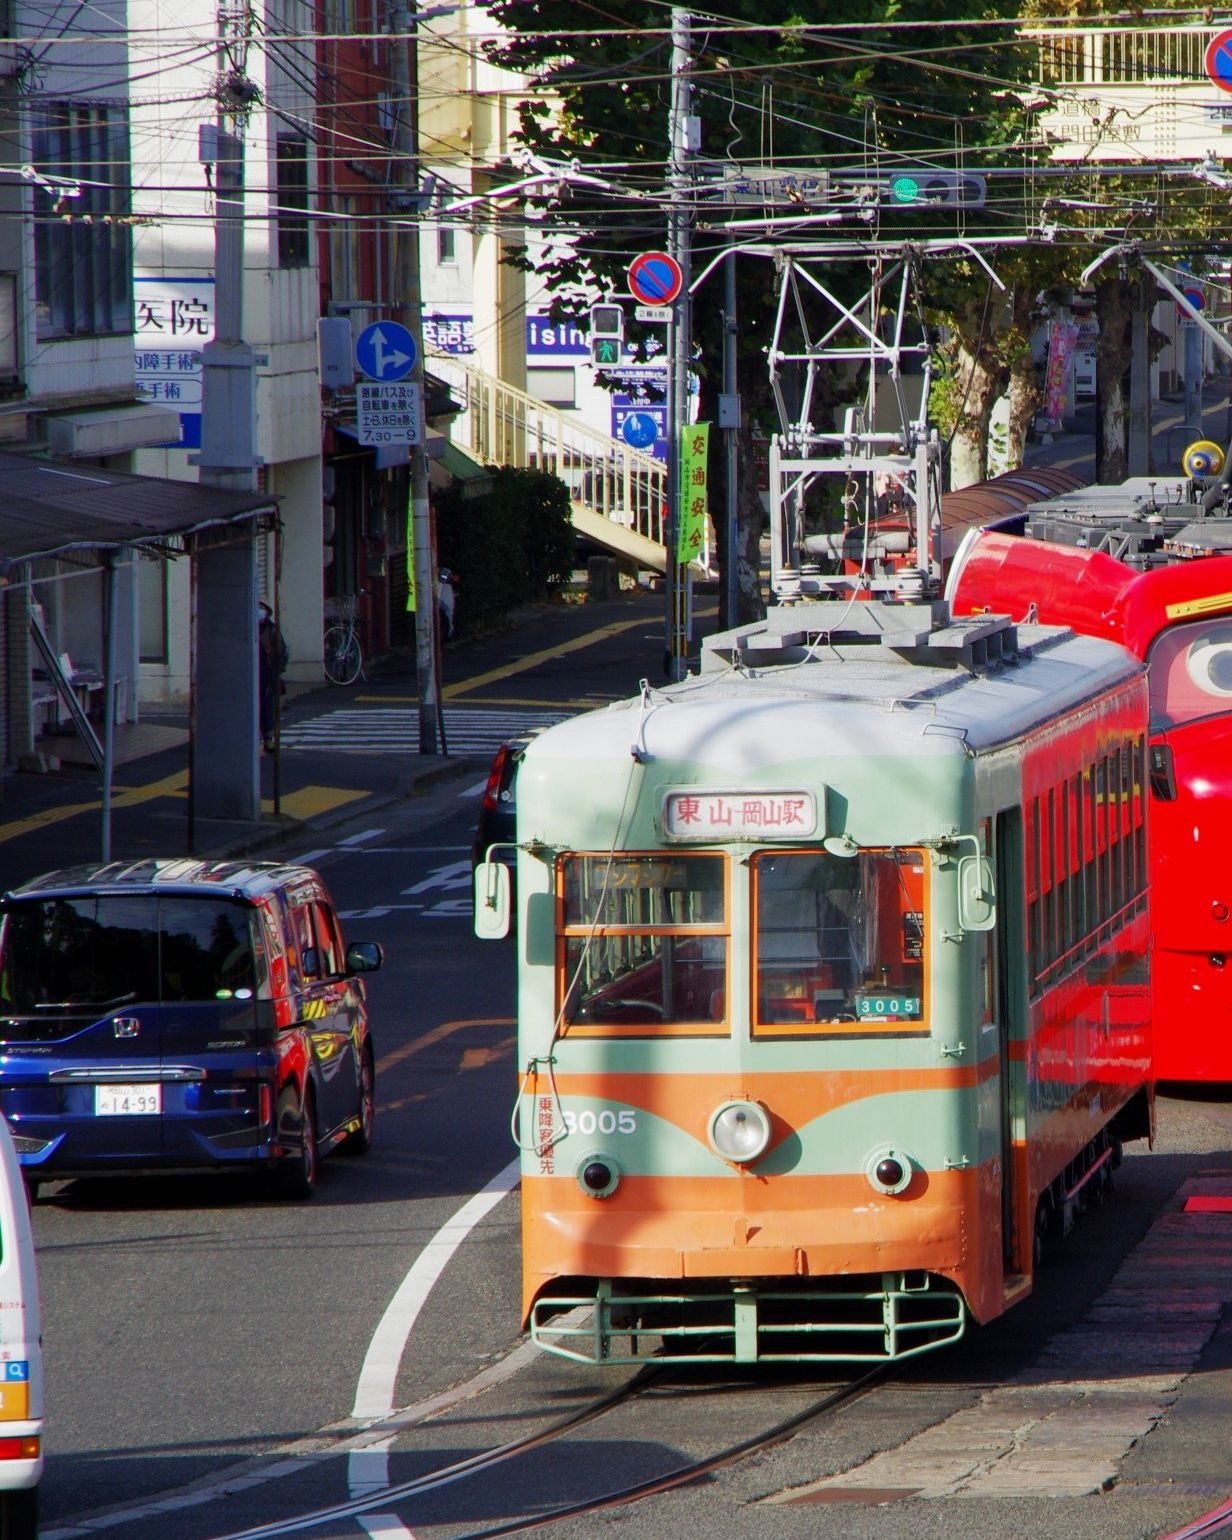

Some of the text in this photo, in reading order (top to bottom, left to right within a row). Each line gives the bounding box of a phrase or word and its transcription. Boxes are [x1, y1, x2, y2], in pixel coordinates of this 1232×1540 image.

[136, 298, 209, 335] 医院
[361, 386, 414, 398] 路線バス及び
[362, 400, 415, 411] 自転車を除く
[690, 434, 705, 548] 交通安全
[861, 1000, 914, 1014] 3005
[113, 1096, 157, 1112] 14-99
[562, 1110, 637, 1135] 3005
[538, 1096, 554, 1174] 乗降客優先
